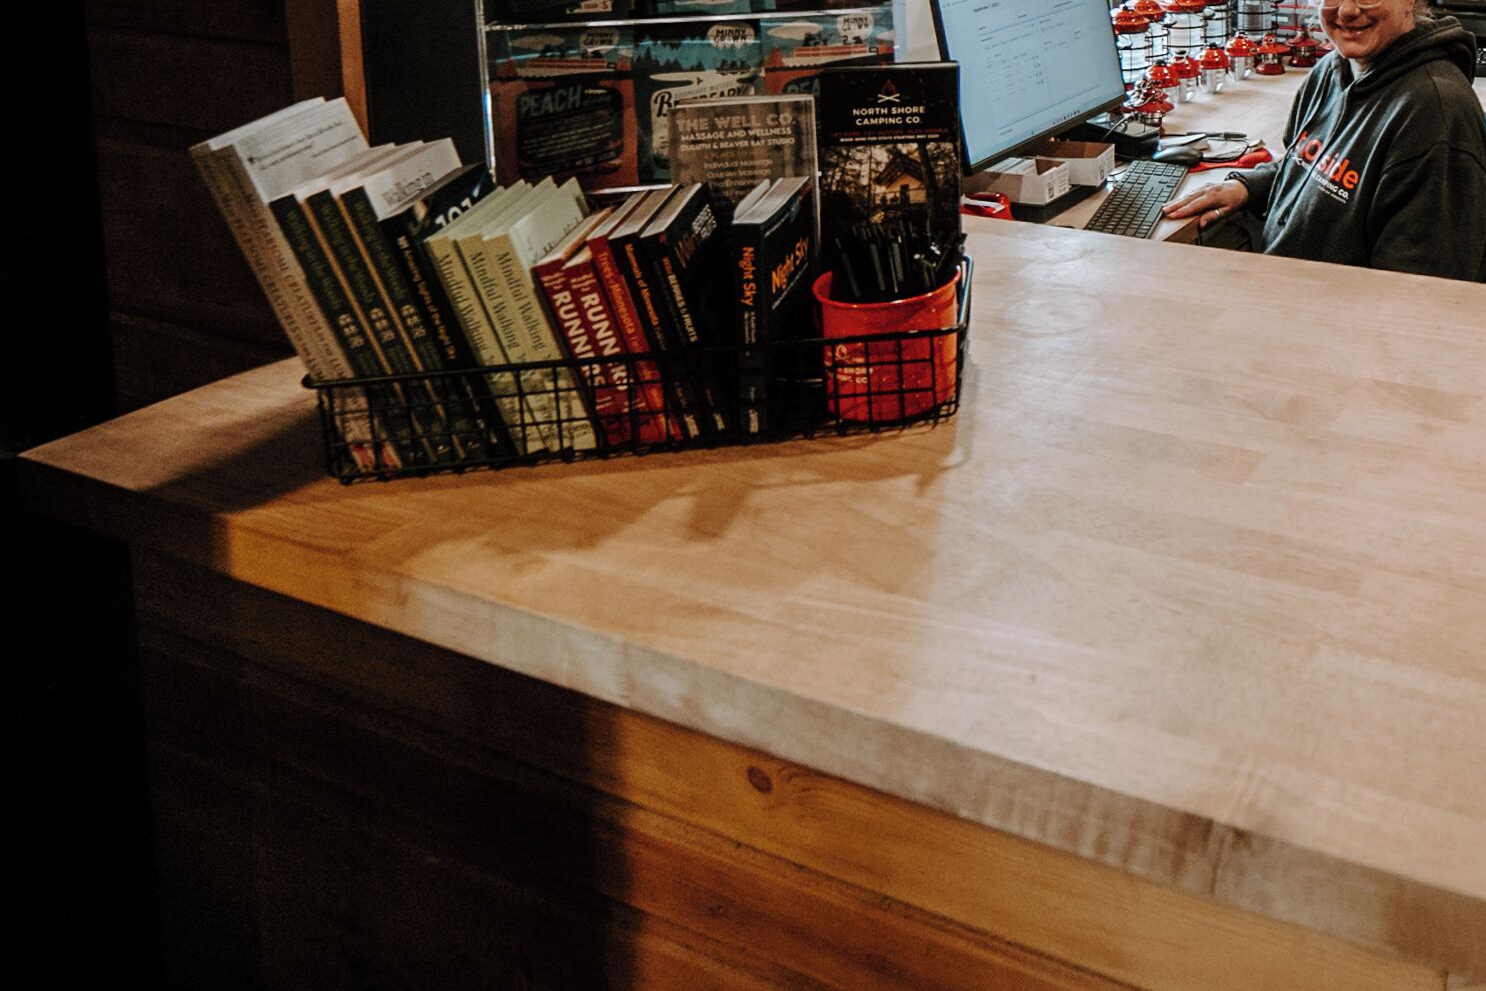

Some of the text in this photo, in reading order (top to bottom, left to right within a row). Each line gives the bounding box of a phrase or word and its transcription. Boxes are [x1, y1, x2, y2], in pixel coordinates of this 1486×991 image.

[518, 84, 583, 117] PEACH
[676, 112, 796, 131] THE WELL CO.
[852, 105, 926, 116] NORTH SHORE
[855, 116, 903, 126] CAMPING
[681, 127, 792, 141] MASSAGE AND WELLNESS
[719, 140, 749, 149] BEAVER
[751, 139, 765, 147] BAY
[767, 137, 795, 146] STUDIO
[435, 252, 490, 353] Mindful Walking
[469, 250, 521, 350] Mindful Walking
[494, 250, 550, 351] Mindful Walking
[596, 250, 616, 279] Trees
[608, 282, 637, 335] Minnesota
[738, 246, 756, 305] Night Sky
[639, 287, 661, 327] Minnesota
[666, 272, 687, 309] BERRIES
[681, 312, 699, 343] FRUITS
[551, 287, 607, 390] RUNNRS
[579, 290, 634, 393] RUNNRS
